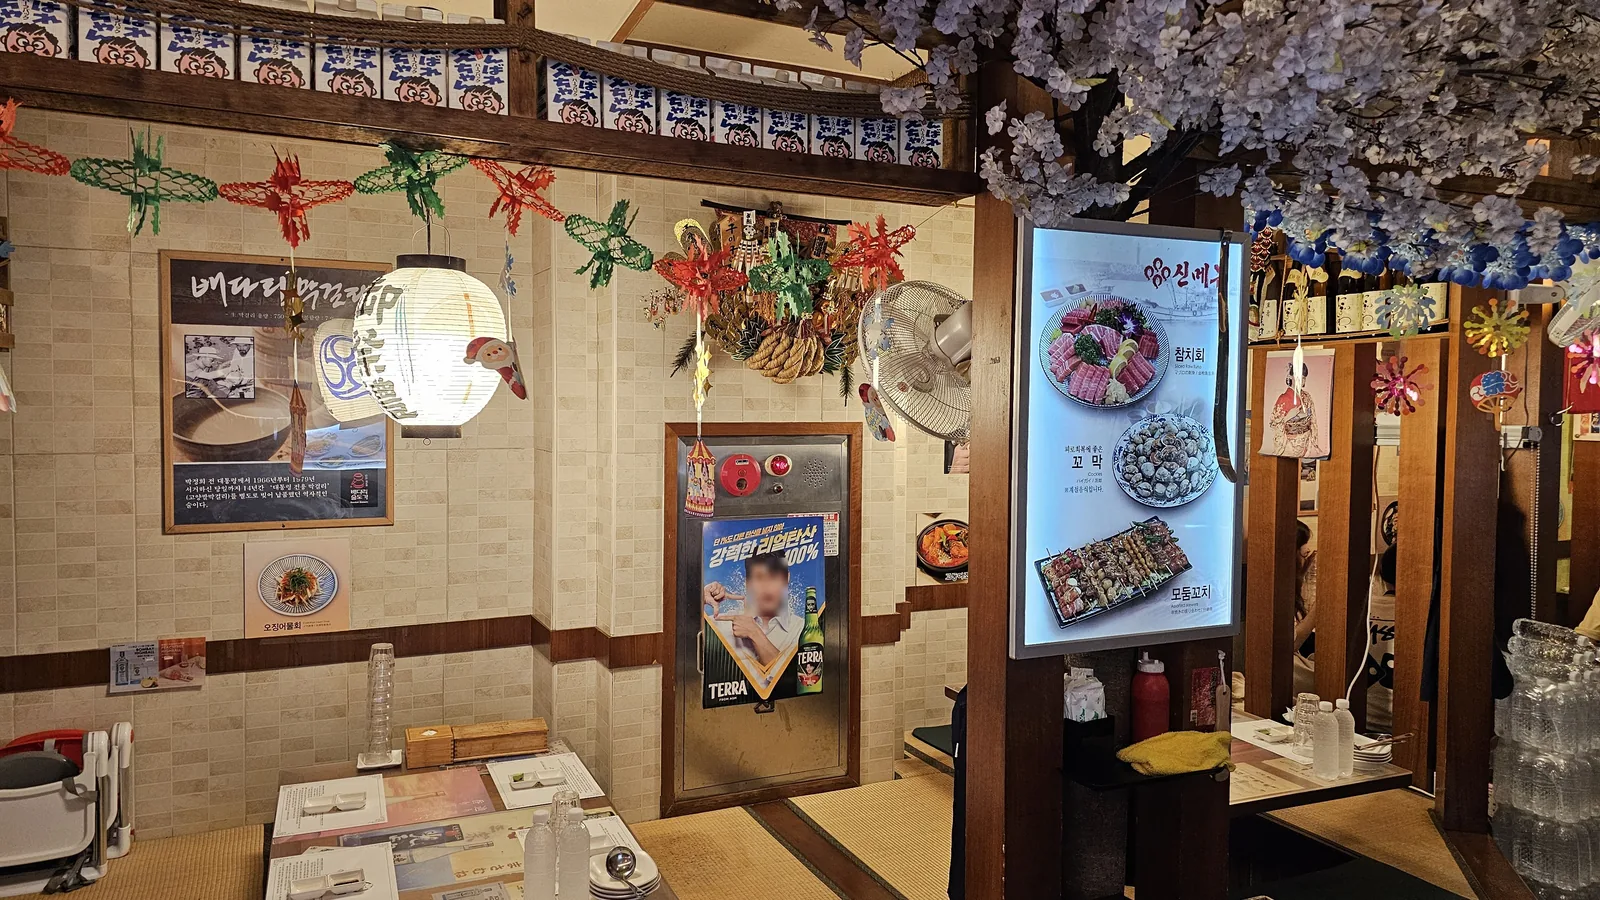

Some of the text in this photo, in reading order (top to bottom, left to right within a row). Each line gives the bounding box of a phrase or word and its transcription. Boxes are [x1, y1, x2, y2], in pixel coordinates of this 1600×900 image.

[191, 271, 286, 307] 배다리
[1174, 346, 1205, 362] 참치회
[1481, 371, 1505, 397] 祭
[1065, 445, 1103, 453] 피로회복에 좋은
[185, 501, 209, 509] 술이다.
[709, 539, 757, 569] 강력한
[756, 524, 818, 556] 리얼탄산
[784, 541, 819, 567] 100%
[1171, 584, 1211, 601] 모둠꼬치
[263, 622, 302, 632] 오징어물회
[798, 650, 823, 665] TERRA
[708, 679, 748, 700] TERRA
